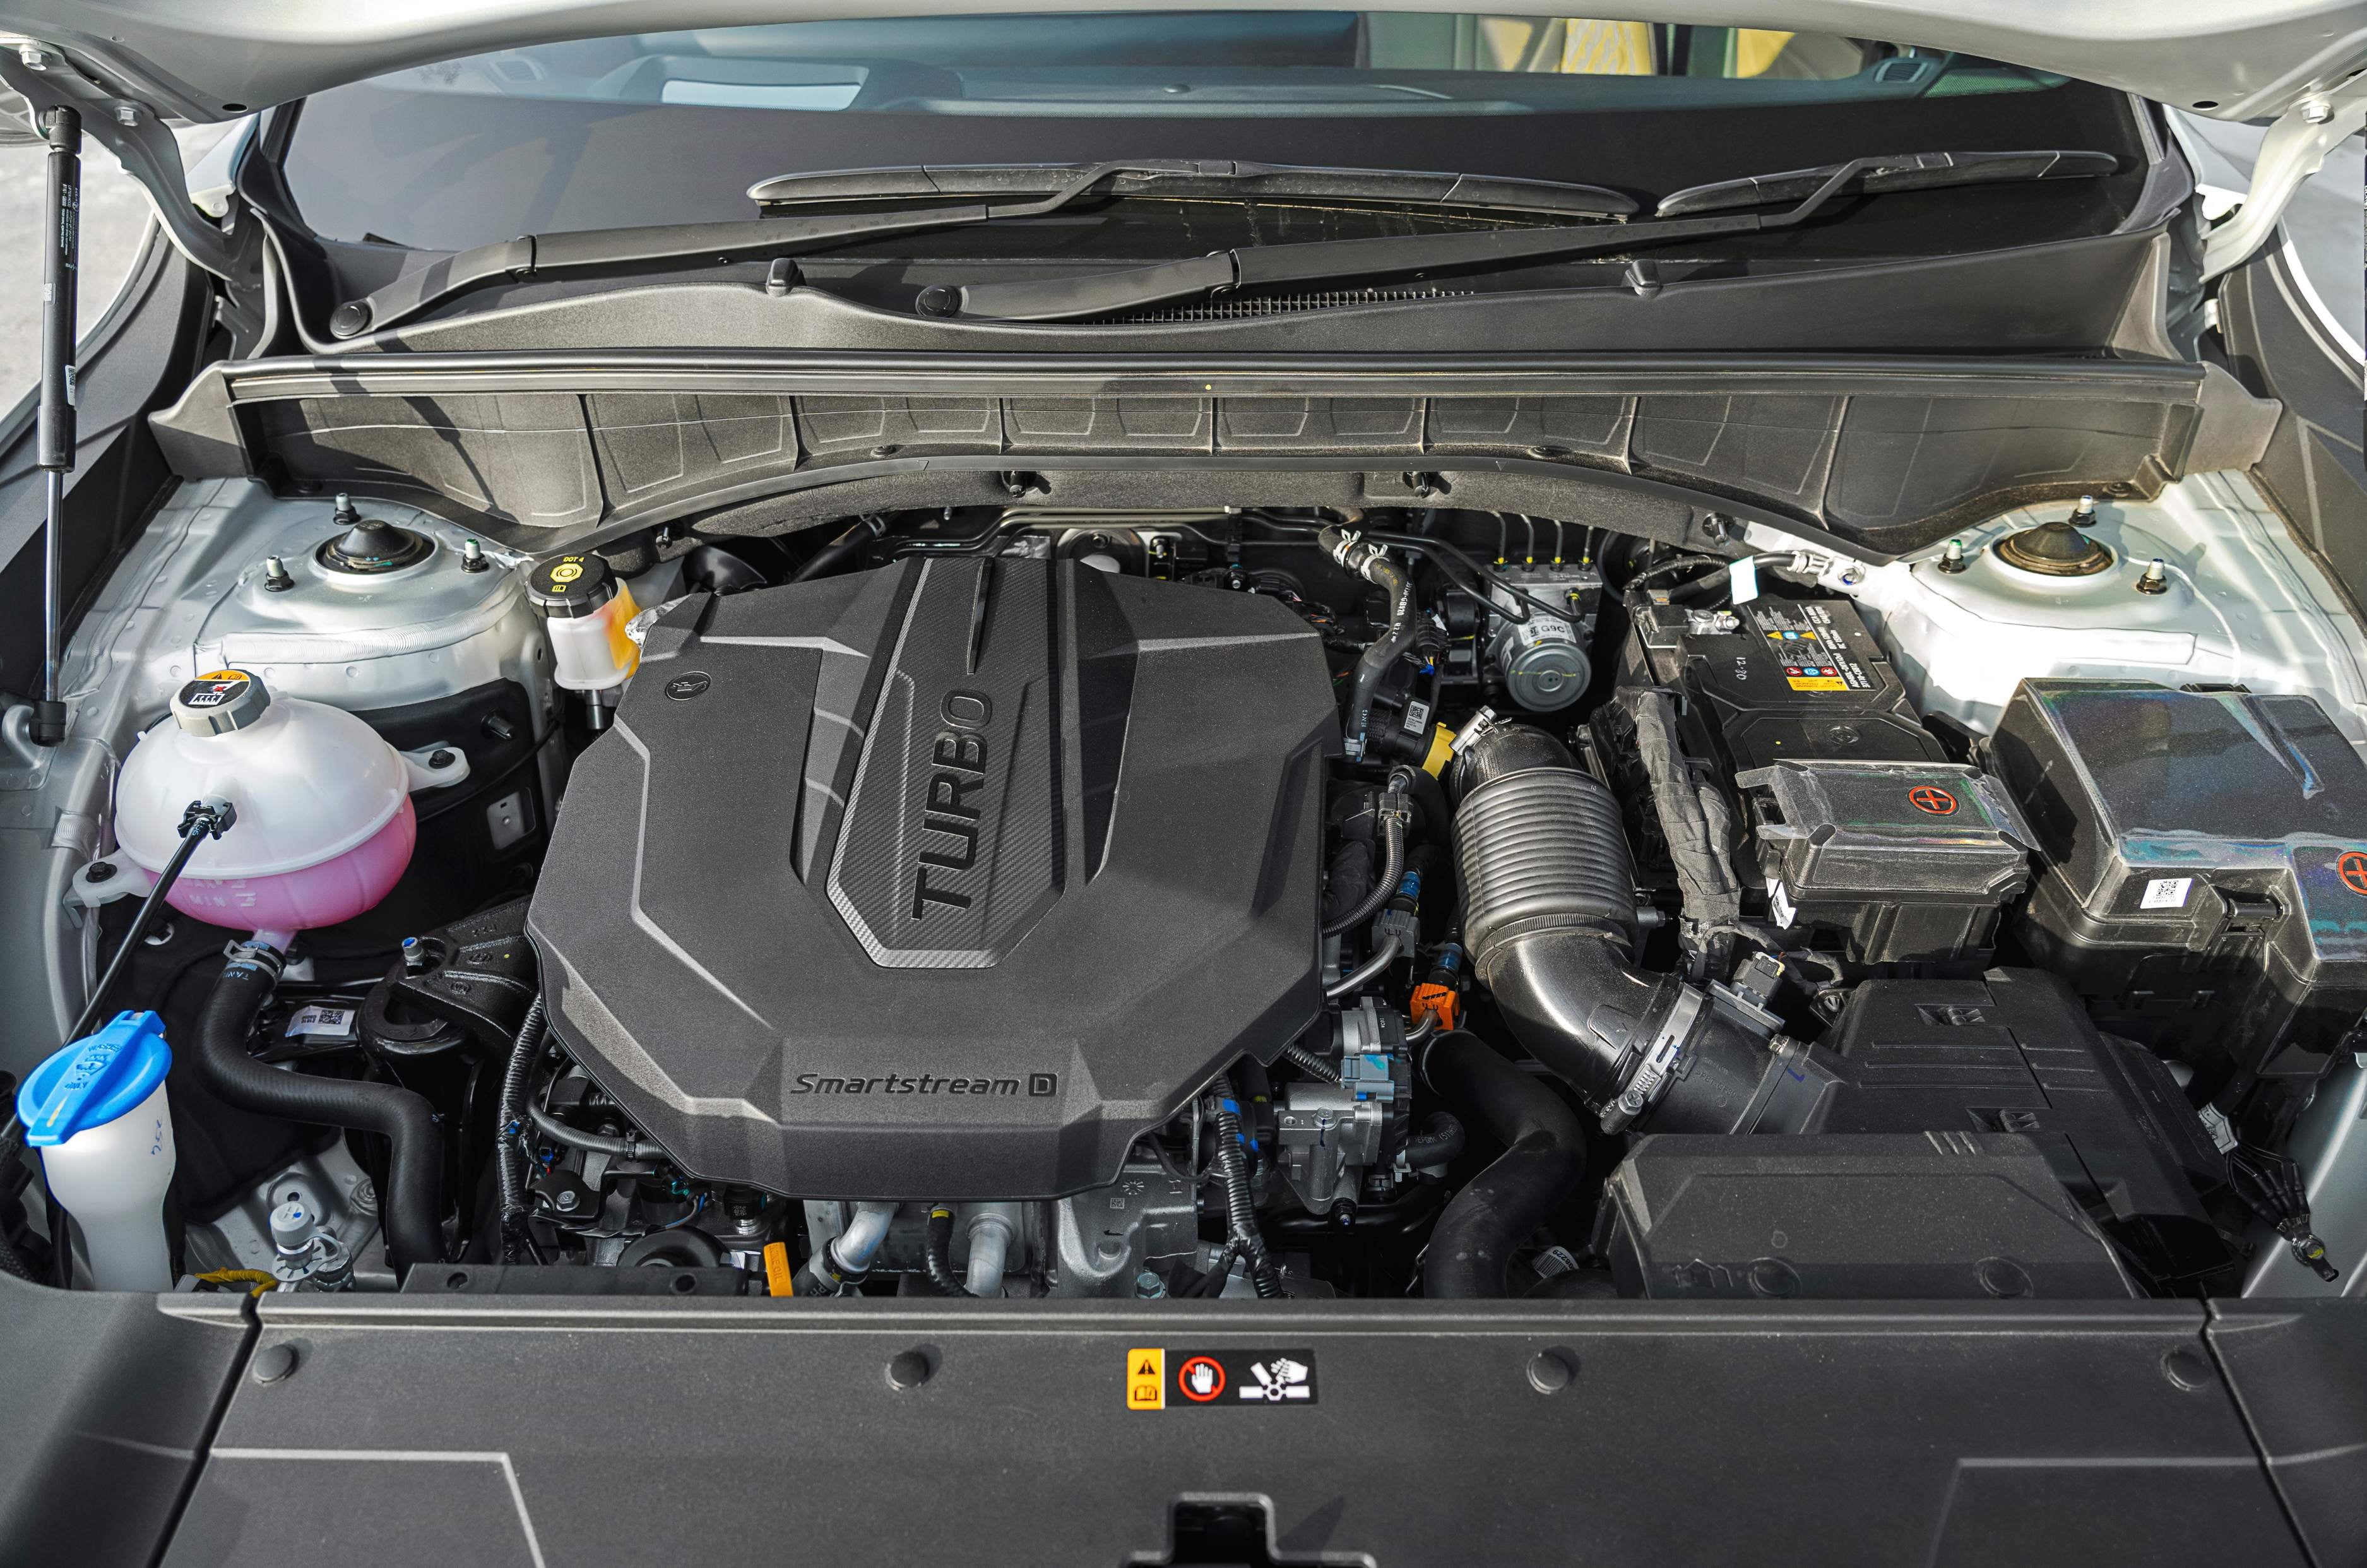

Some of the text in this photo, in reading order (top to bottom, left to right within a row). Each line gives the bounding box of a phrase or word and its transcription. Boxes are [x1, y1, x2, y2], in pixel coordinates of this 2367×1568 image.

[911, 689, 992, 920] TURBO
[790, 1072, 1057, 1096] Smartstream D
